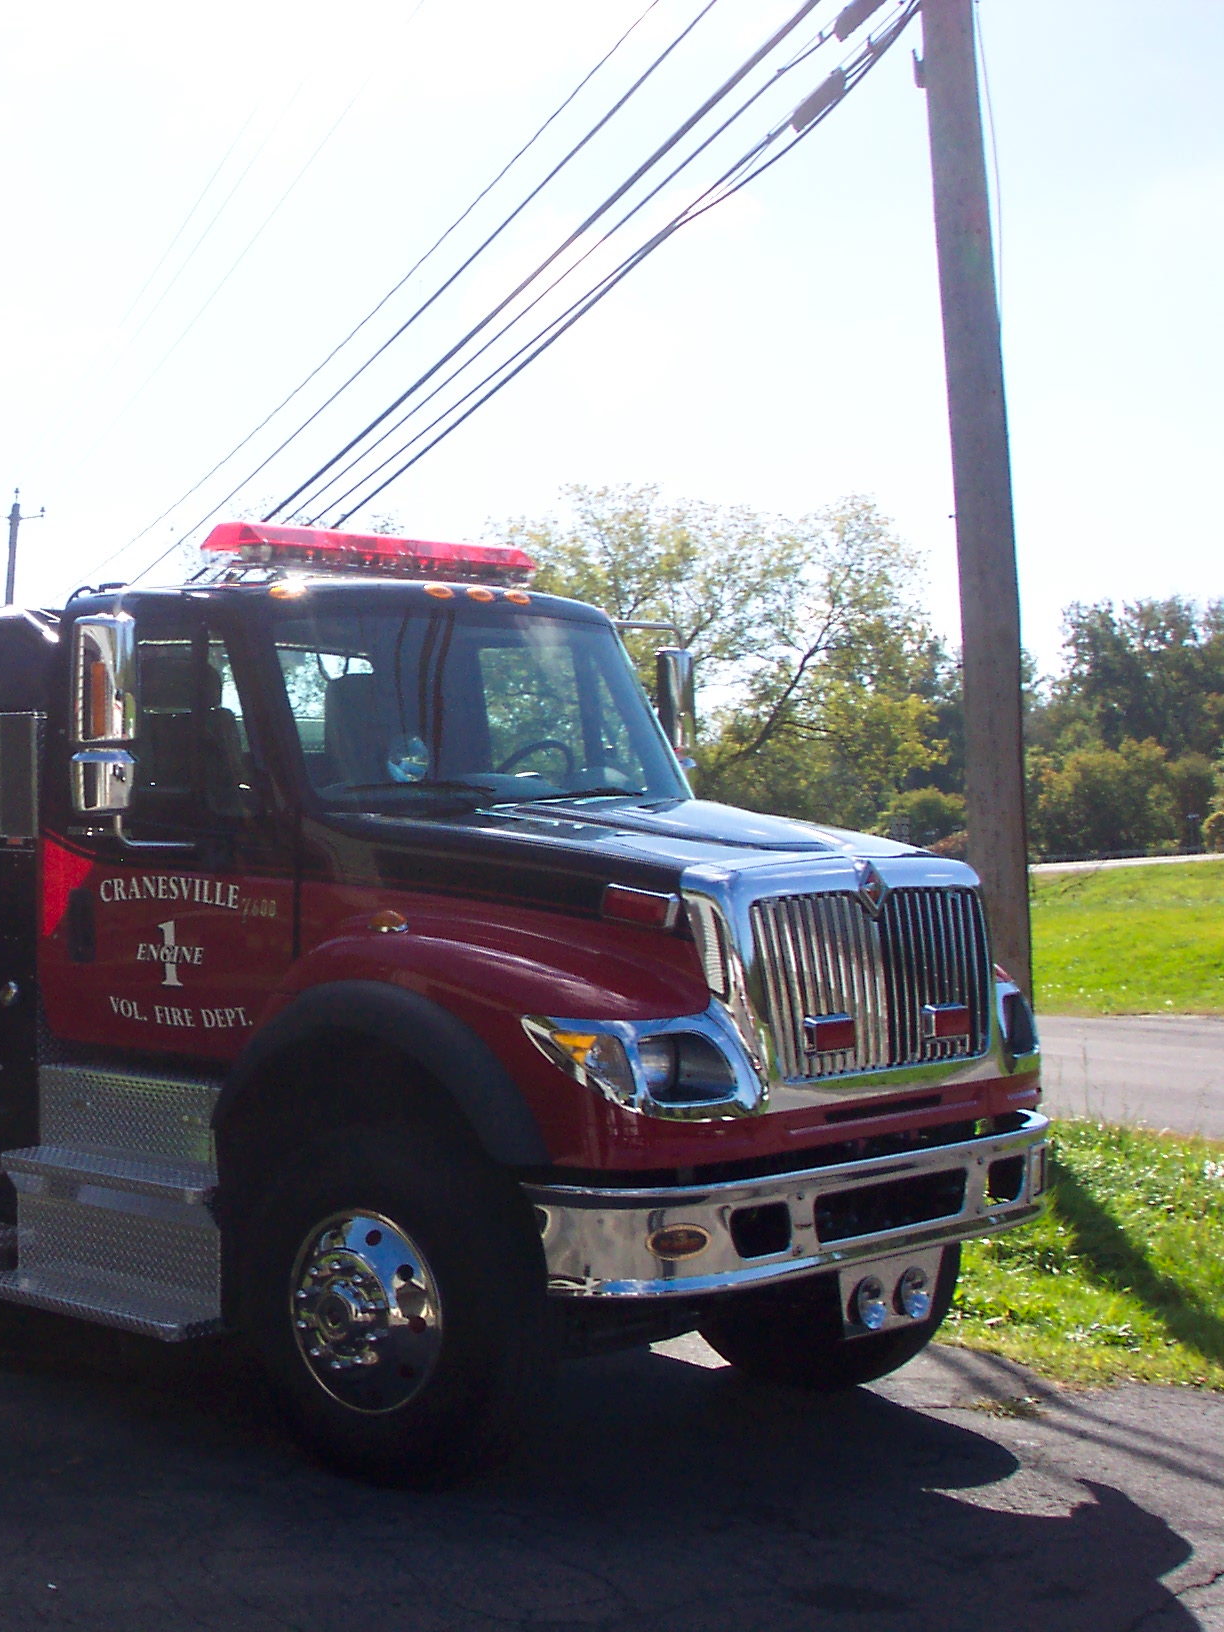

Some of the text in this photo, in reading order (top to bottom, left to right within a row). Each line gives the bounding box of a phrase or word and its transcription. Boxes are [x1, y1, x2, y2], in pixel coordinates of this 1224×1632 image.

[100, 876, 239, 909] CRANESVILLE
[136, 943, 204, 965] ENGINE
[109, 996, 254, 1028] VOL. FIRE DEPT.
